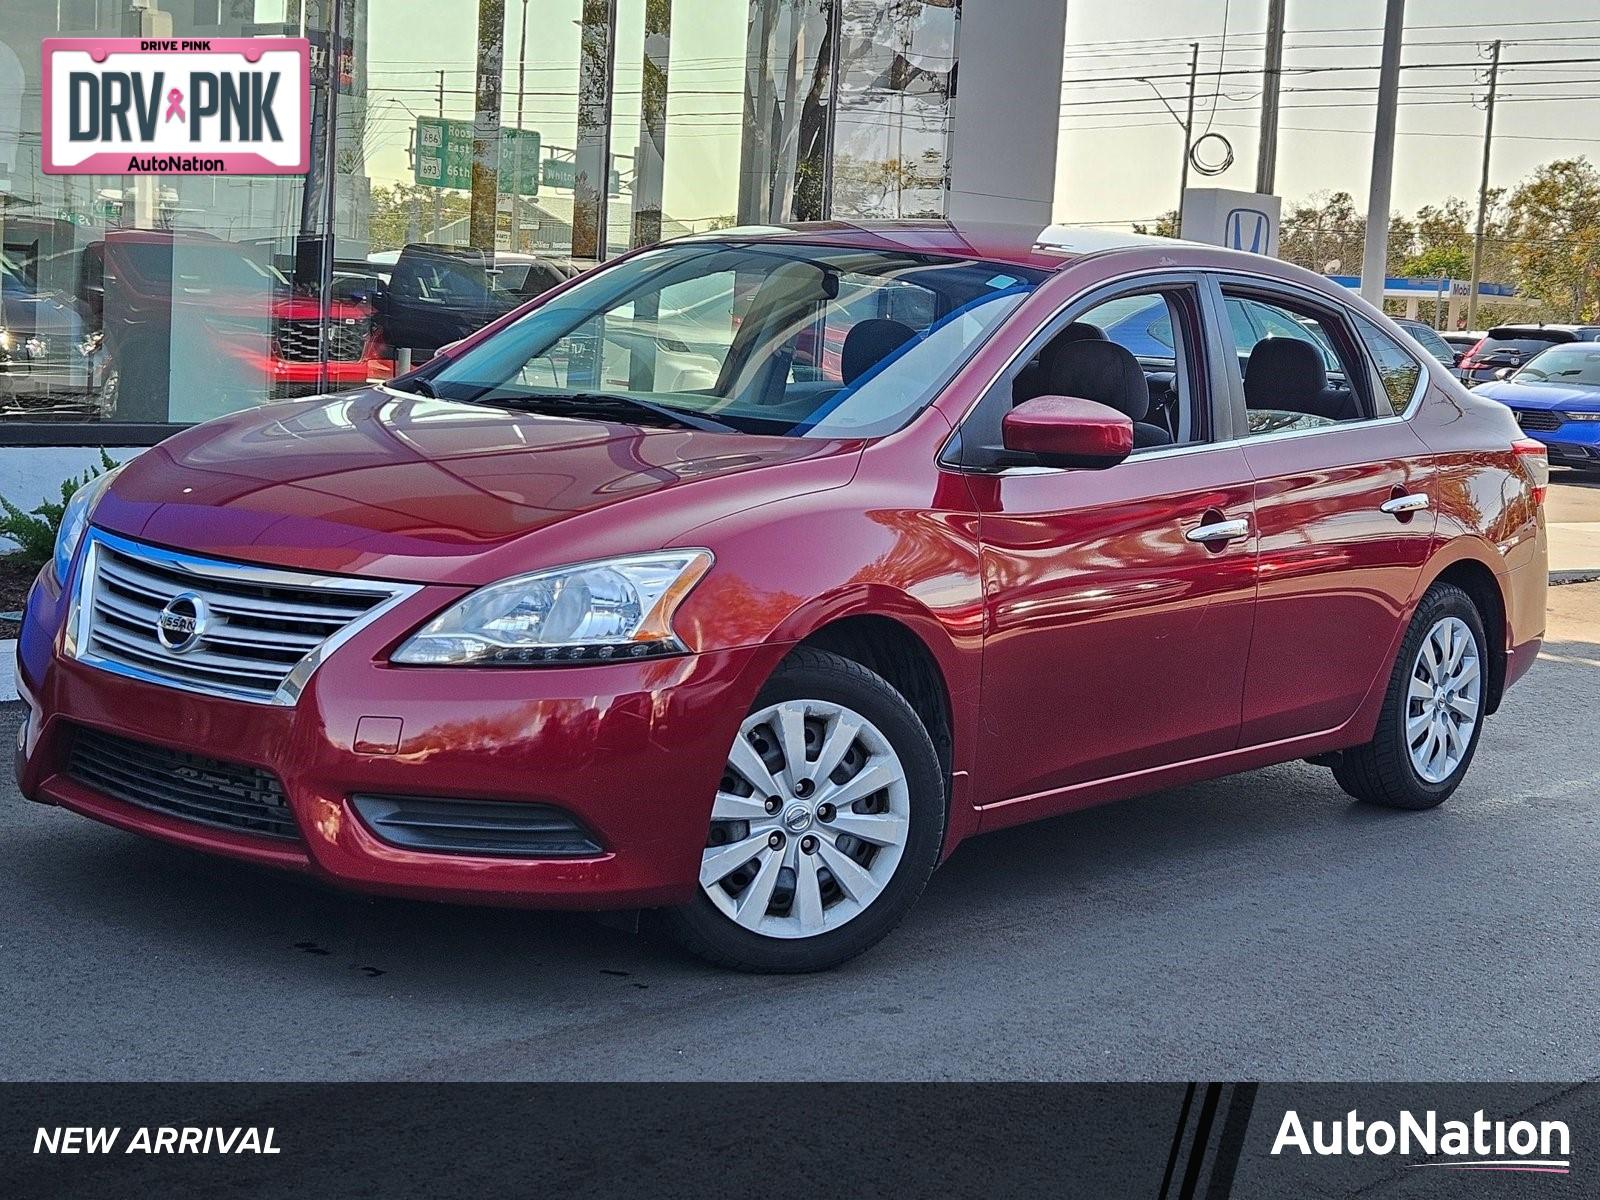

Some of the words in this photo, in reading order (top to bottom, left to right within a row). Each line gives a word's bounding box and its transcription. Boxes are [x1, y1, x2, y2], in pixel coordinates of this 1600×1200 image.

[424, 132, 439, 144] 686
[447, 142, 470, 154] East
[503, 149, 514, 159] Dr
[423, 165, 437, 175] 693
[446, 165, 470, 177] 66th
[160, 613, 196, 632] NISSAN
